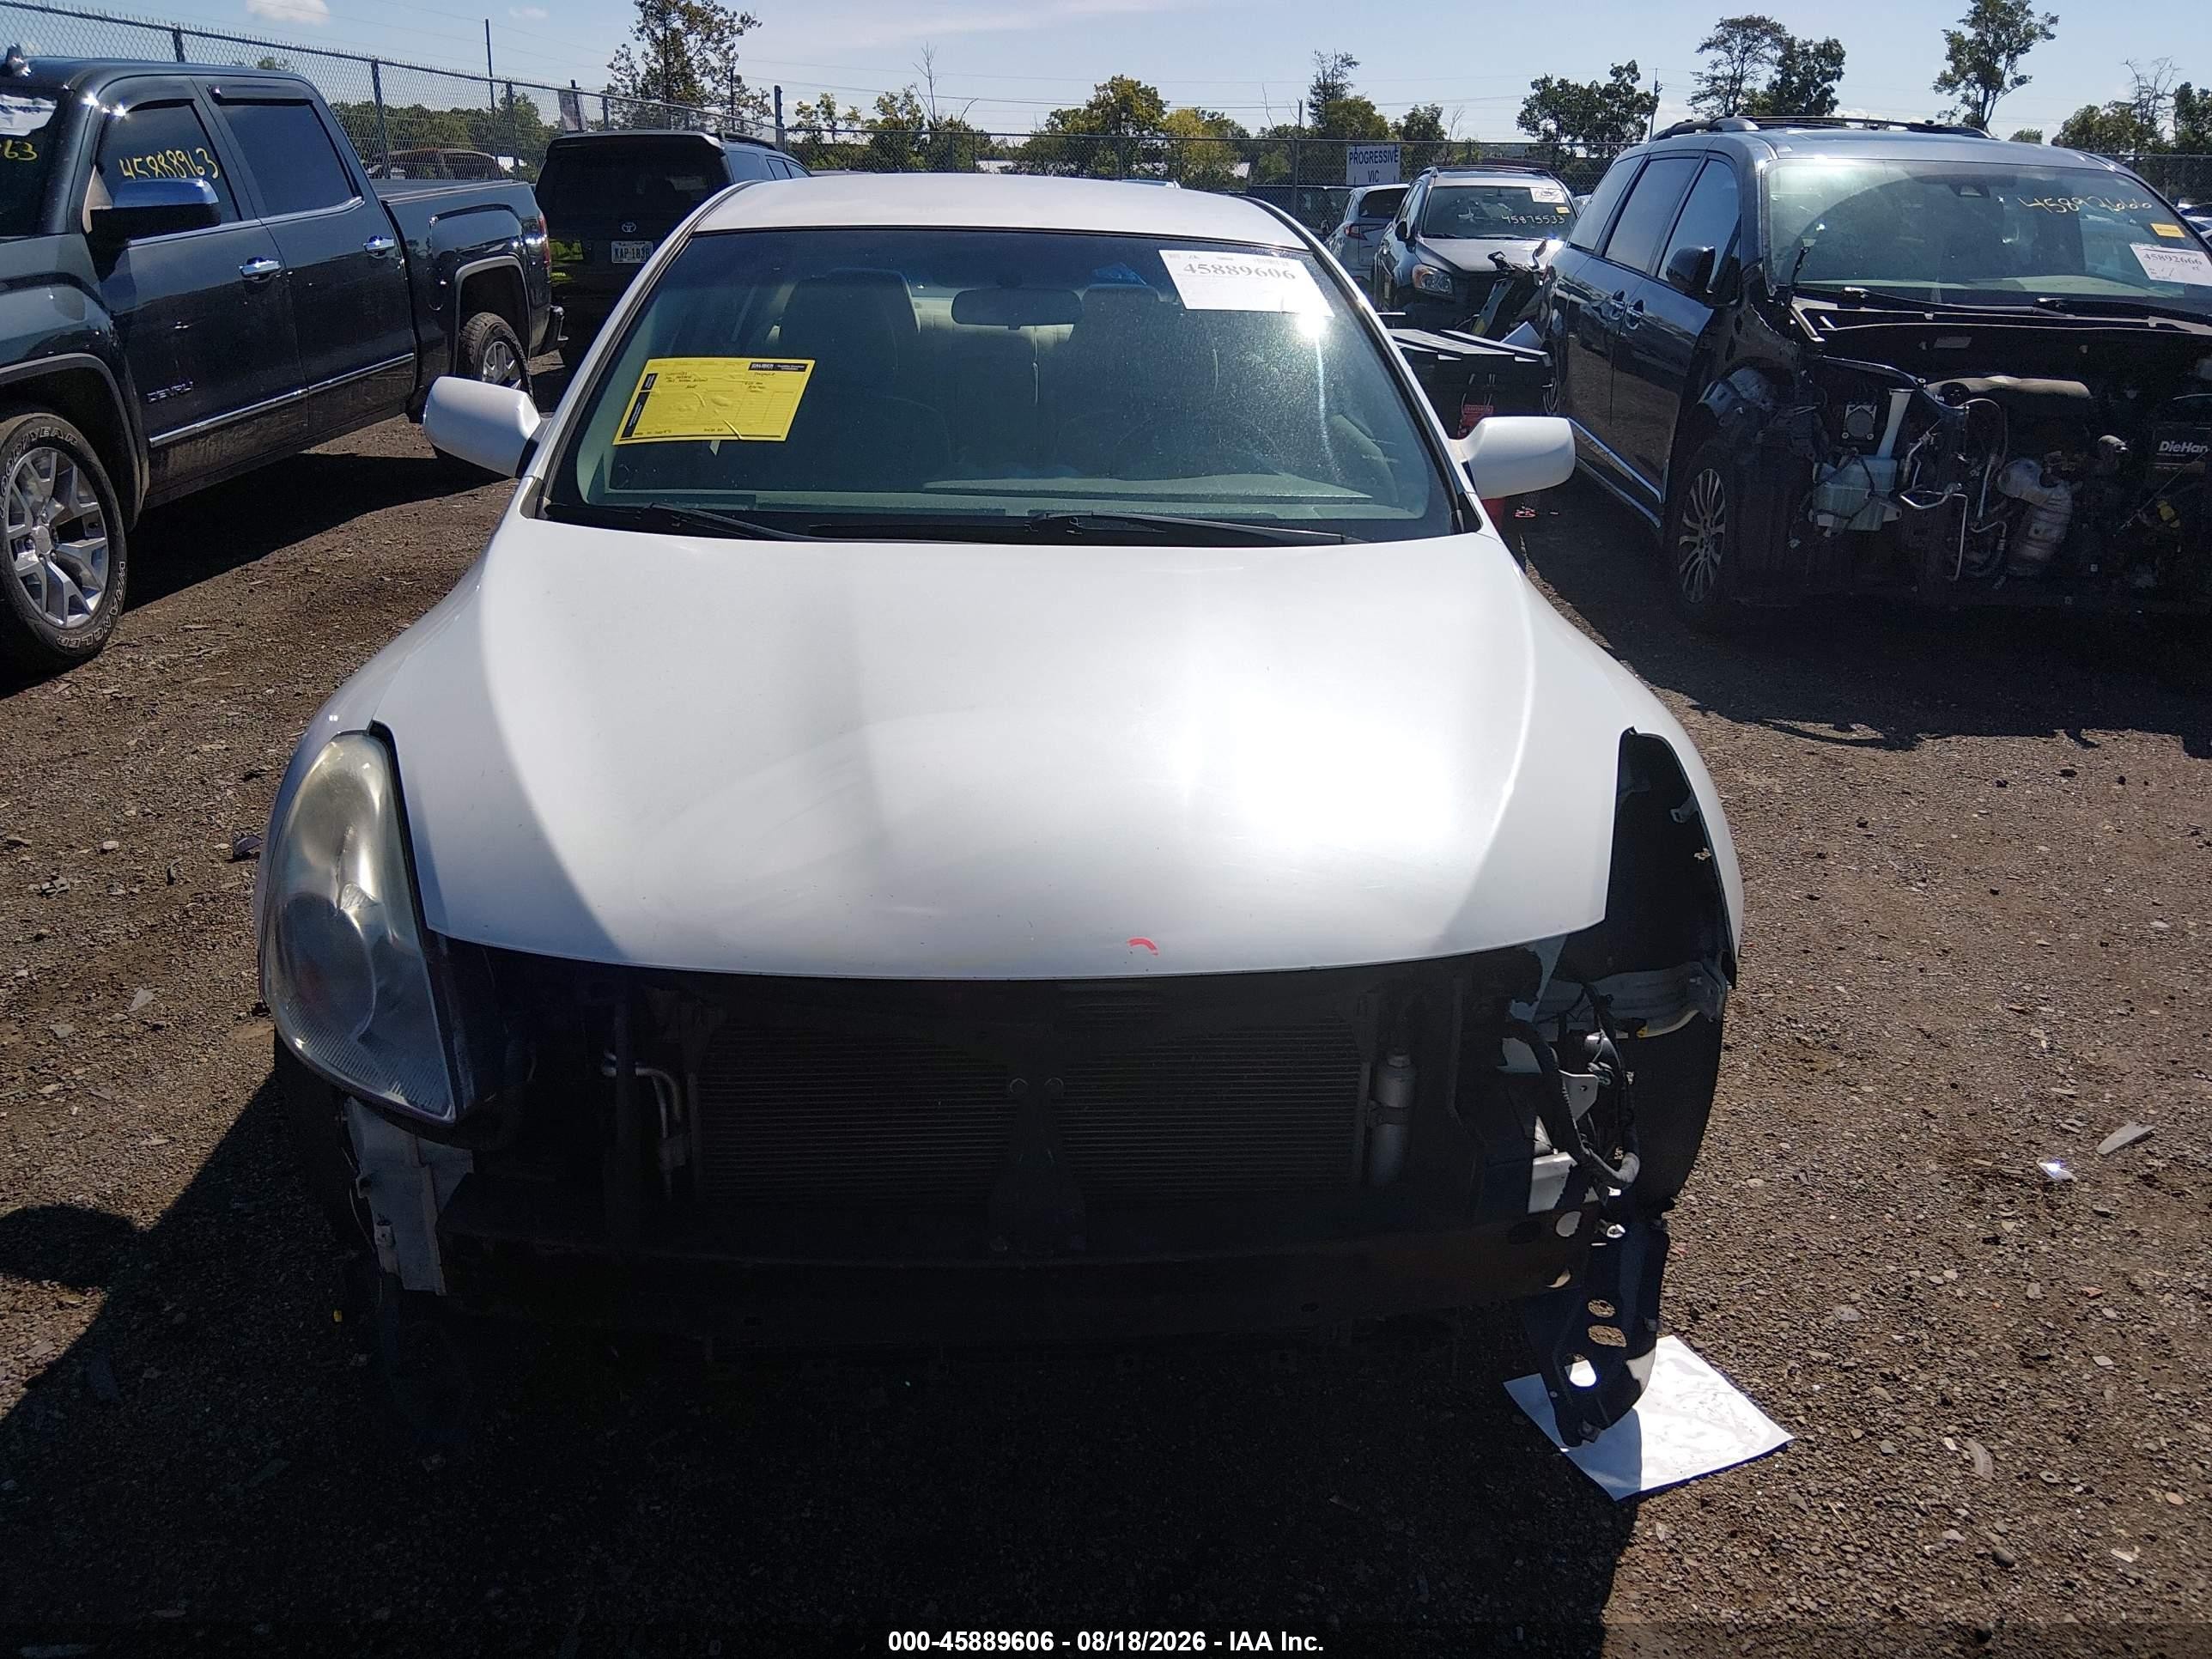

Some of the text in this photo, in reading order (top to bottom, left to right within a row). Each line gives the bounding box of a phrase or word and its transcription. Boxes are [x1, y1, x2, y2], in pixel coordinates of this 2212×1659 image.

[1349, 149, 1399, 165] PROGRESSIVE
[1367, 169, 1380, 183] VIC
[1501, 215, 1565, 224] 45875533
[1183, 263, 1296, 280] 45889606
[57, 561, 126, 648] WRANGLER
